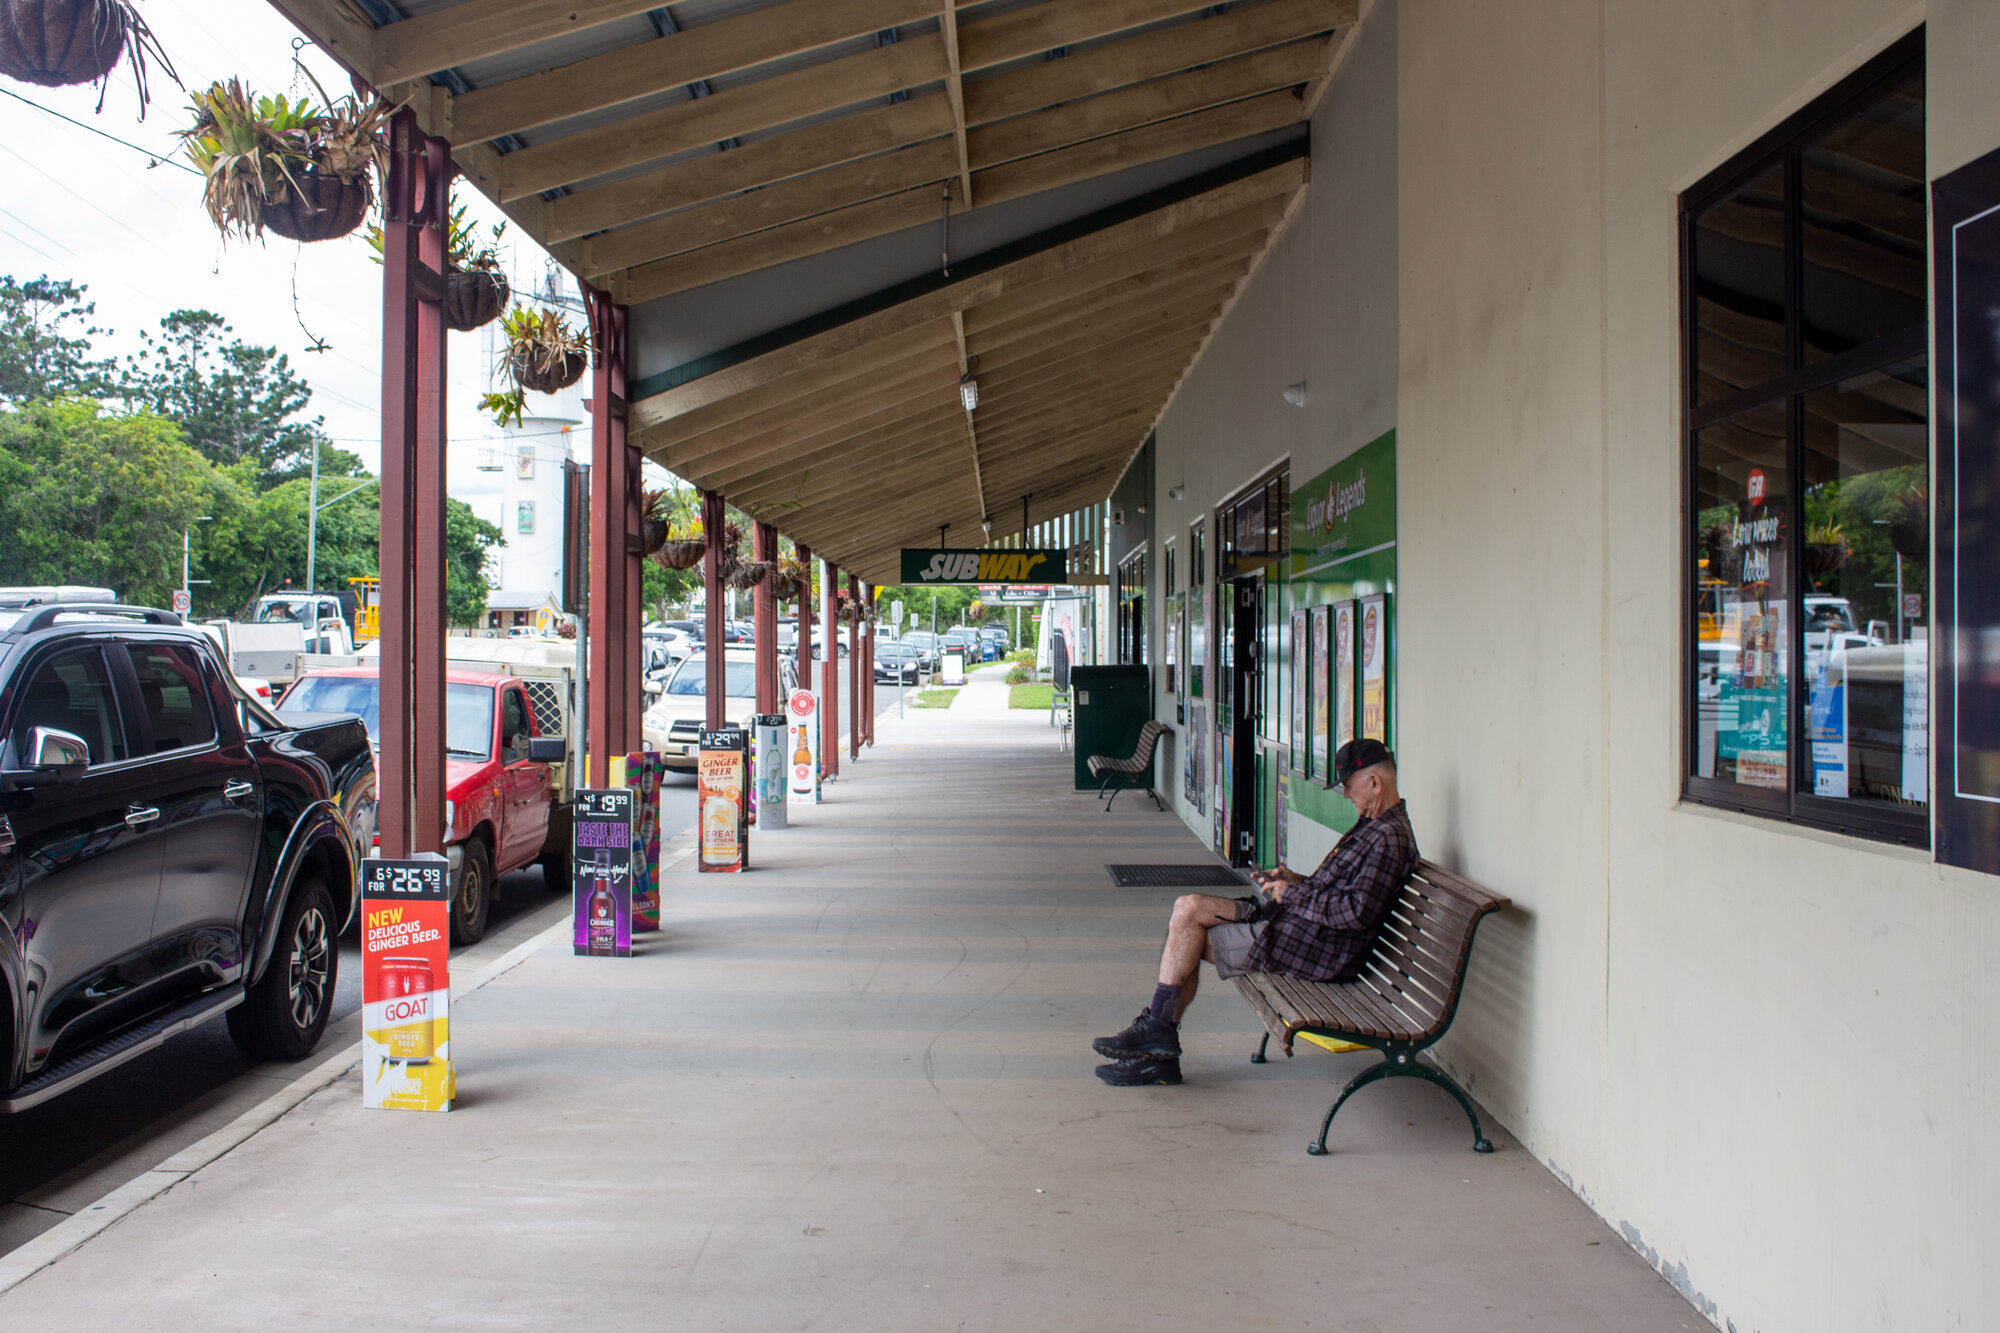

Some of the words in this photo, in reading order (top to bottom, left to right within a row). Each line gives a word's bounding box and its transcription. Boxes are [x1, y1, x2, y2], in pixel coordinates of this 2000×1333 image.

[1306, 497, 1325, 538] Liquor
[1335, 465, 1366, 526] Legends
[920, 551, 1047, 582] SUBWAY
[176, 597, 188, 606] 50
[703, 758, 739, 768] GINGER
[709, 768, 732, 777] BEER
[584, 795, 590, 803] 4
[579, 803, 591, 811] FOR
[578, 822, 608, 836] TASTE
[609, 822, 629, 837] THE
[705, 830, 735, 838] GREAT
[578, 835, 606, 847] DARK
[606, 836, 629, 848] SIDE
[376, 867, 385, 881] 6
[368, 881, 385, 892] FOR
[632, 900, 655, 910] LLSON'S
[368, 906, 403, 929] NEW
[368, 920, 420, 940] DELICIOUS
[368, 935, 409, 952] GINGER
[412, 929, 442, 944] BEER.
[385, 997, 429, 1021] GOAT
